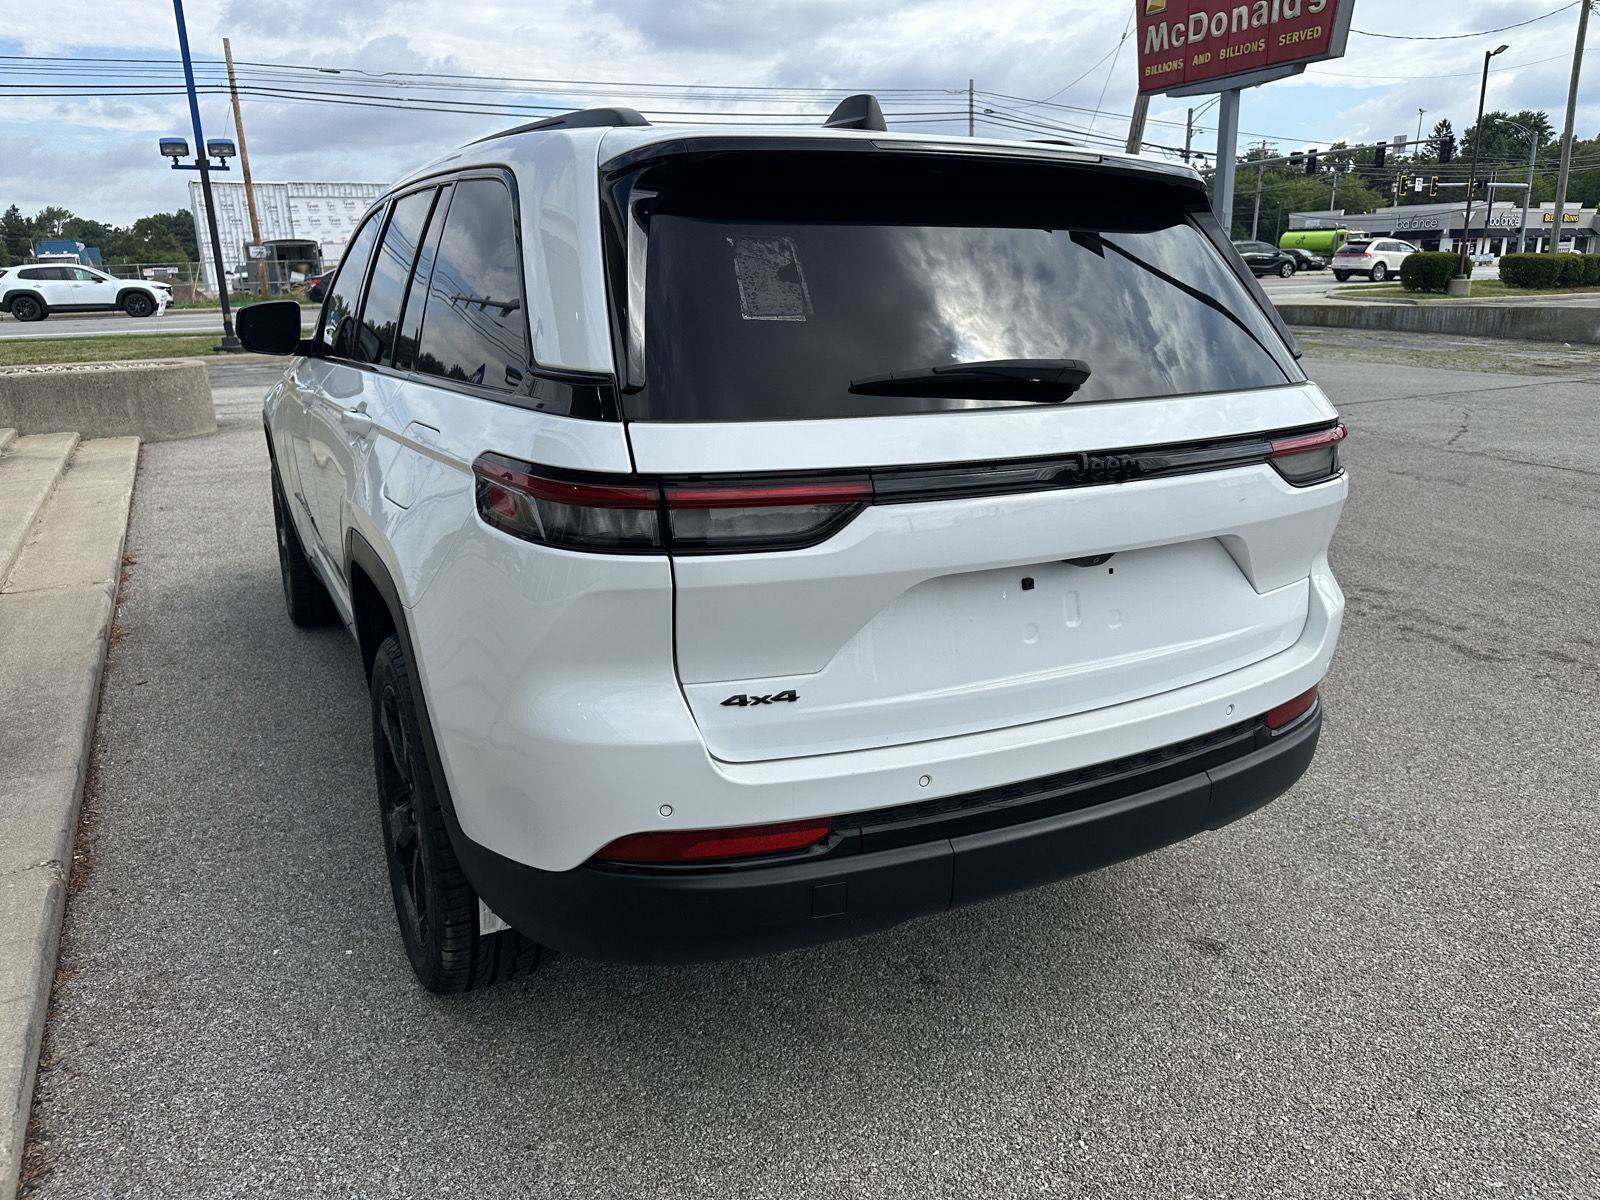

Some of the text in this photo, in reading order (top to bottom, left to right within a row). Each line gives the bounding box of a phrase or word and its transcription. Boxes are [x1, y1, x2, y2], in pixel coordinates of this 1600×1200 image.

[1144, 0, 1327, 55] McDonalds
[1145, 26, 1322, 77] BILLIONS AND BILLIONS SERVED
[1072, 453, 1138, 482] Jeep
[720, 690, 800, 706] 4x4
